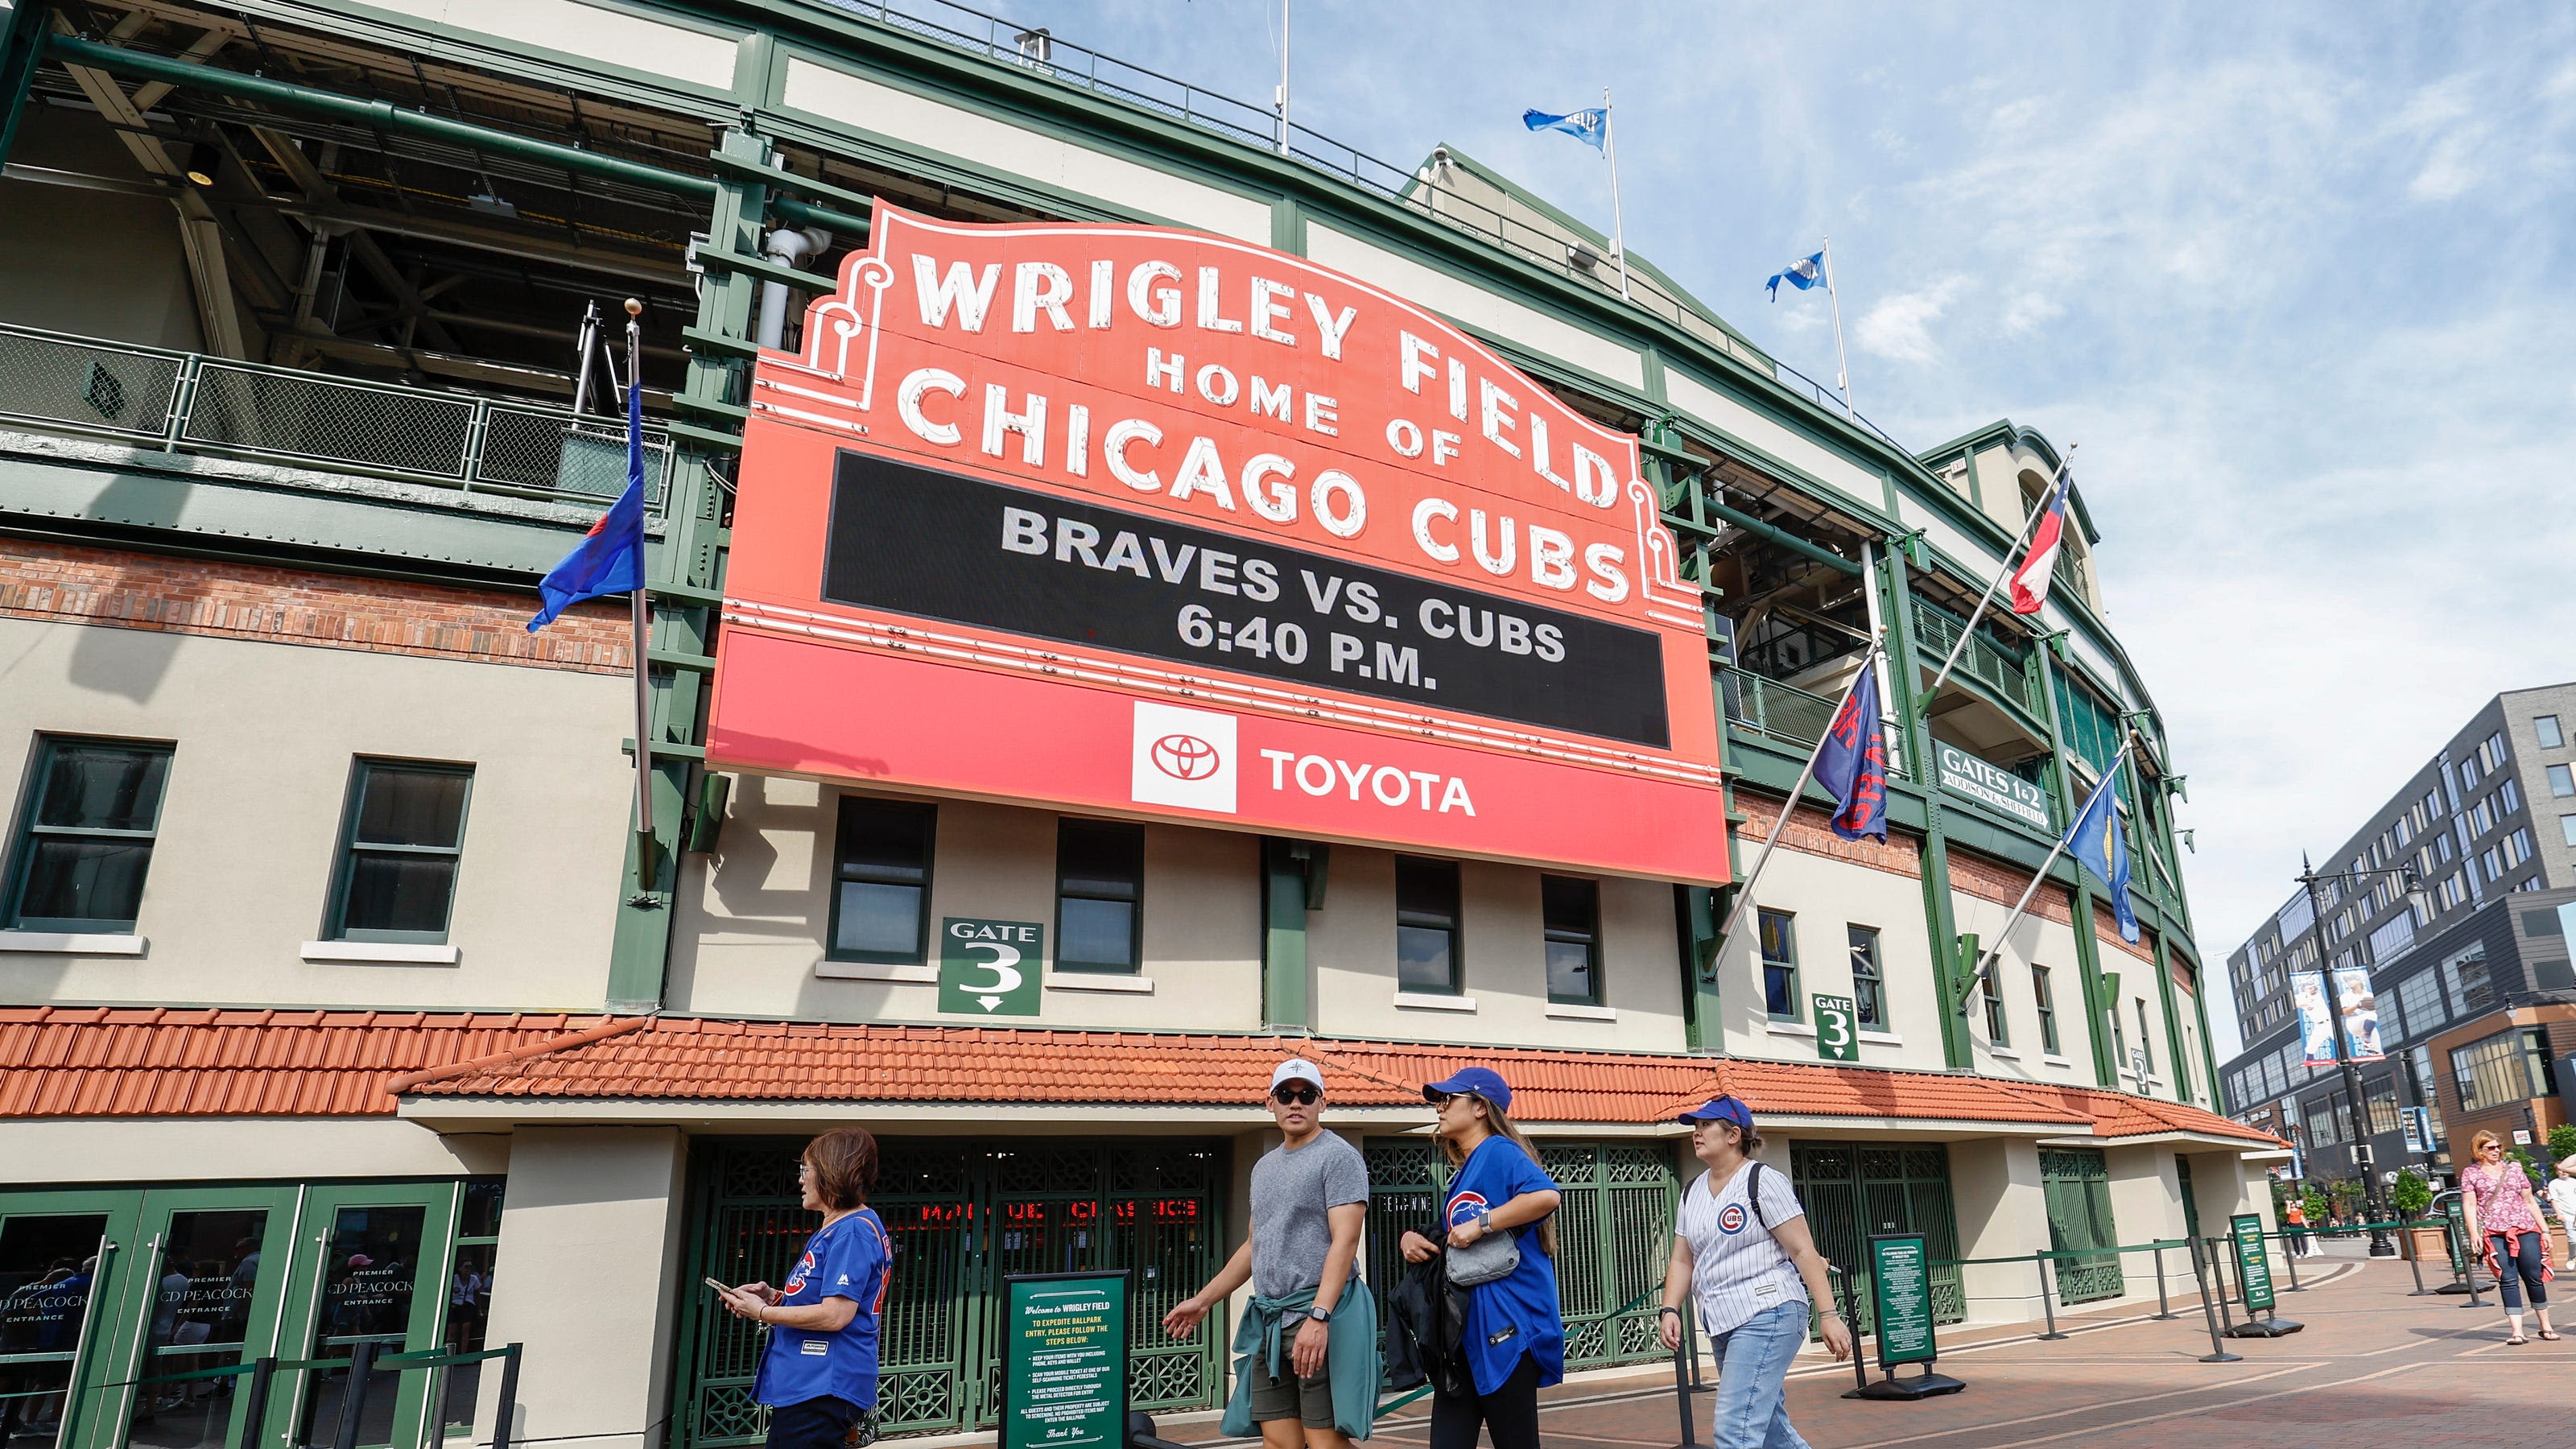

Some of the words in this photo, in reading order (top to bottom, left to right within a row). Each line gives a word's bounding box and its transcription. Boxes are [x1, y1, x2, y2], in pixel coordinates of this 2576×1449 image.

[911, 254, 1358, 361] WRIGLEY
[1400, 329, 1619, 509] FIELD
[1147, 347, 1339, 436] HOME
[1387, 419, 1460, 466] OF
[898, 367, 1366, 537] CHICAGO
[1412, 497, 1629, 602] CUBS
[1001, 506, 1281, 602] BRAVES
[1300, 570, 1398, 630] VS.
[1418, 598, 1567, 663] CUBS
[1177, 604, 1308, 666] 6:40
[1331, 632, 1437, 691] P.M.
[1943, 749, 2009, 793] GATES
[1261, 748, 1476, 817] TOYOTA
[1948, 775, 1991, 799] ADDISON
[1992, 791, 2000, 804] &
[2001, 798, 2045, 824] SHEFFIELD
[950, 923, 1036, 942] GATE
[959, 942, 1022, 994] 3
[1815, 997, 1852, 1011] GATE
[1823, 1010, 1850, 1046] 3
[2132, 1050, 2145, 1060] GATE
[2135, 1059, 2147, 1085] 3
[188, 1276, 232, 1284] PREMIER
[160, 1290, 181, 1302] CD
[183, 1287, 254, 1302] PEACOCK
[328, 1282, 347, 1295] CD
[349, 1281, 414, 1294] PEACOCK
[13, 1294, 87, 1310] PEACOCK
[344, 1298, 394, 1307] ENTRANCE
[1025, 1306, 1053, 1315] Welcome
[1063, 1302, 1091, 1312] WRIGLEY
[1092, 1302, 1109, 1311] FIELD
[176, 1306, 231, 1315] ENTRANCE
[6, 1314, 65, 1323] ENTRANCE
[1072, 1316, 1102, 1324] BALLPARK
[1048, 1327, 1070, 1335] PLEASE
[1072, 1326, 1096, 1334] FOLLOW
[1067, 1336, 1088, 1344] BELOW:
[1046, 1428, 1068, 1438] Thank
[1071, 1427, 1084, 1438] You
